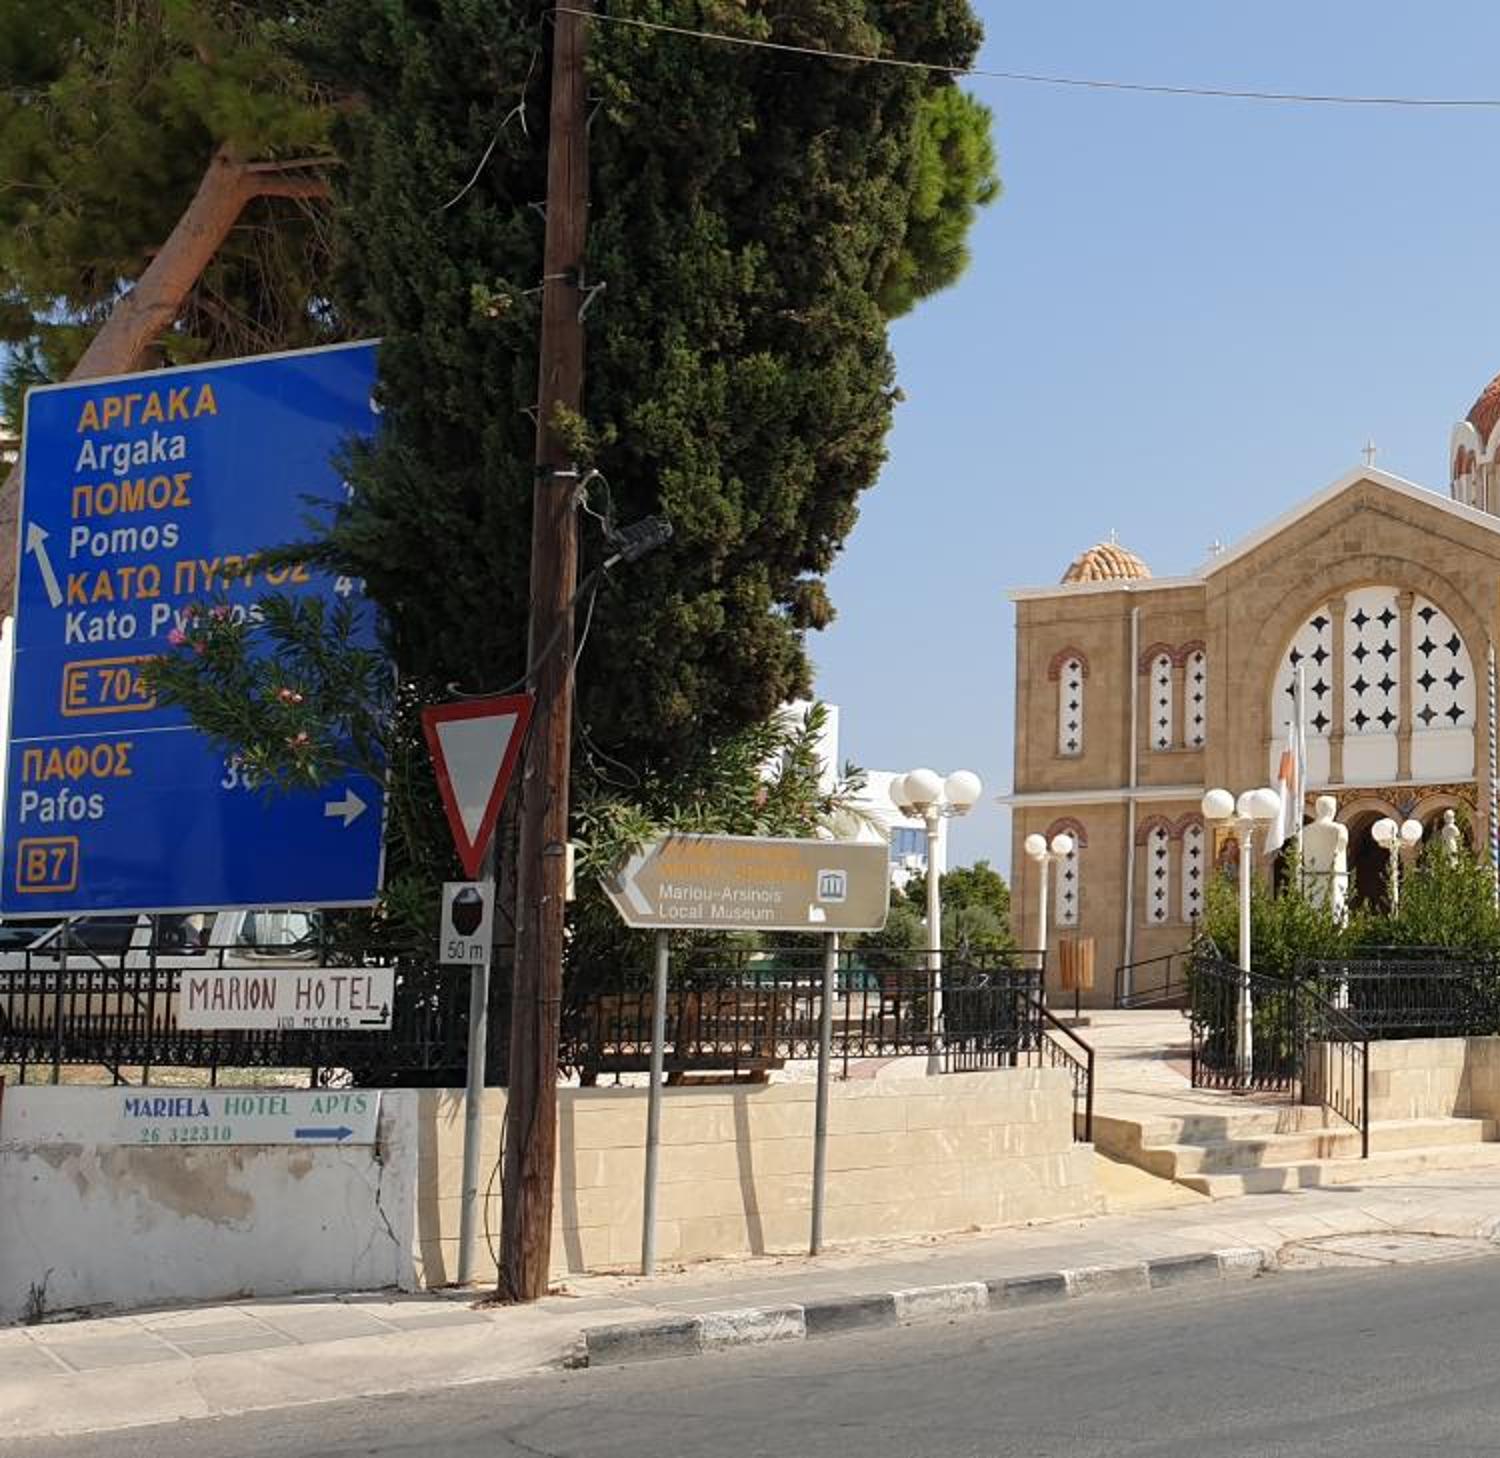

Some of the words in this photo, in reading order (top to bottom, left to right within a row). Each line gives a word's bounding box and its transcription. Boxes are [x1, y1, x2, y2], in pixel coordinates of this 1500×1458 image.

[77, 384, 218, 432] ΑΡΓΑΚΑ
[75, 432, 186, 477] Argaka
[71, 472, 192, 519] ΠΟΜΟΣ
[69, 518, 180, 559] Pomos
[66, 563, 161, 606] ΚΑΤΩ
[65, 611, 137, 644] Kato
[67, 672, 89, 705] E
[22, 741, 132, 782] ΠΑΦΟΣ
[19, 786, 104, 823] Pafos
[26, 847, 66, 883] B7
[659, 884, 783, 903] Mariou-Arsinois
[659, 903, 703, 919] Local
[711, 904, 776, 920] Museum
[447, 940, 466, 959] 50
[469, 945, 483, 959] m
[188, 977, 277, 1010] MARION
[295, 976, 382, 1012] HOTEL
[303, 1016, 351, 1028] METERS
[123, 1096, 211, 1119] MARIELA
[224, 1098, 290, 1117] HOTEL
[140, 1126, 161, 1143] 26
[168, 1125, 232, 1143] 322310
